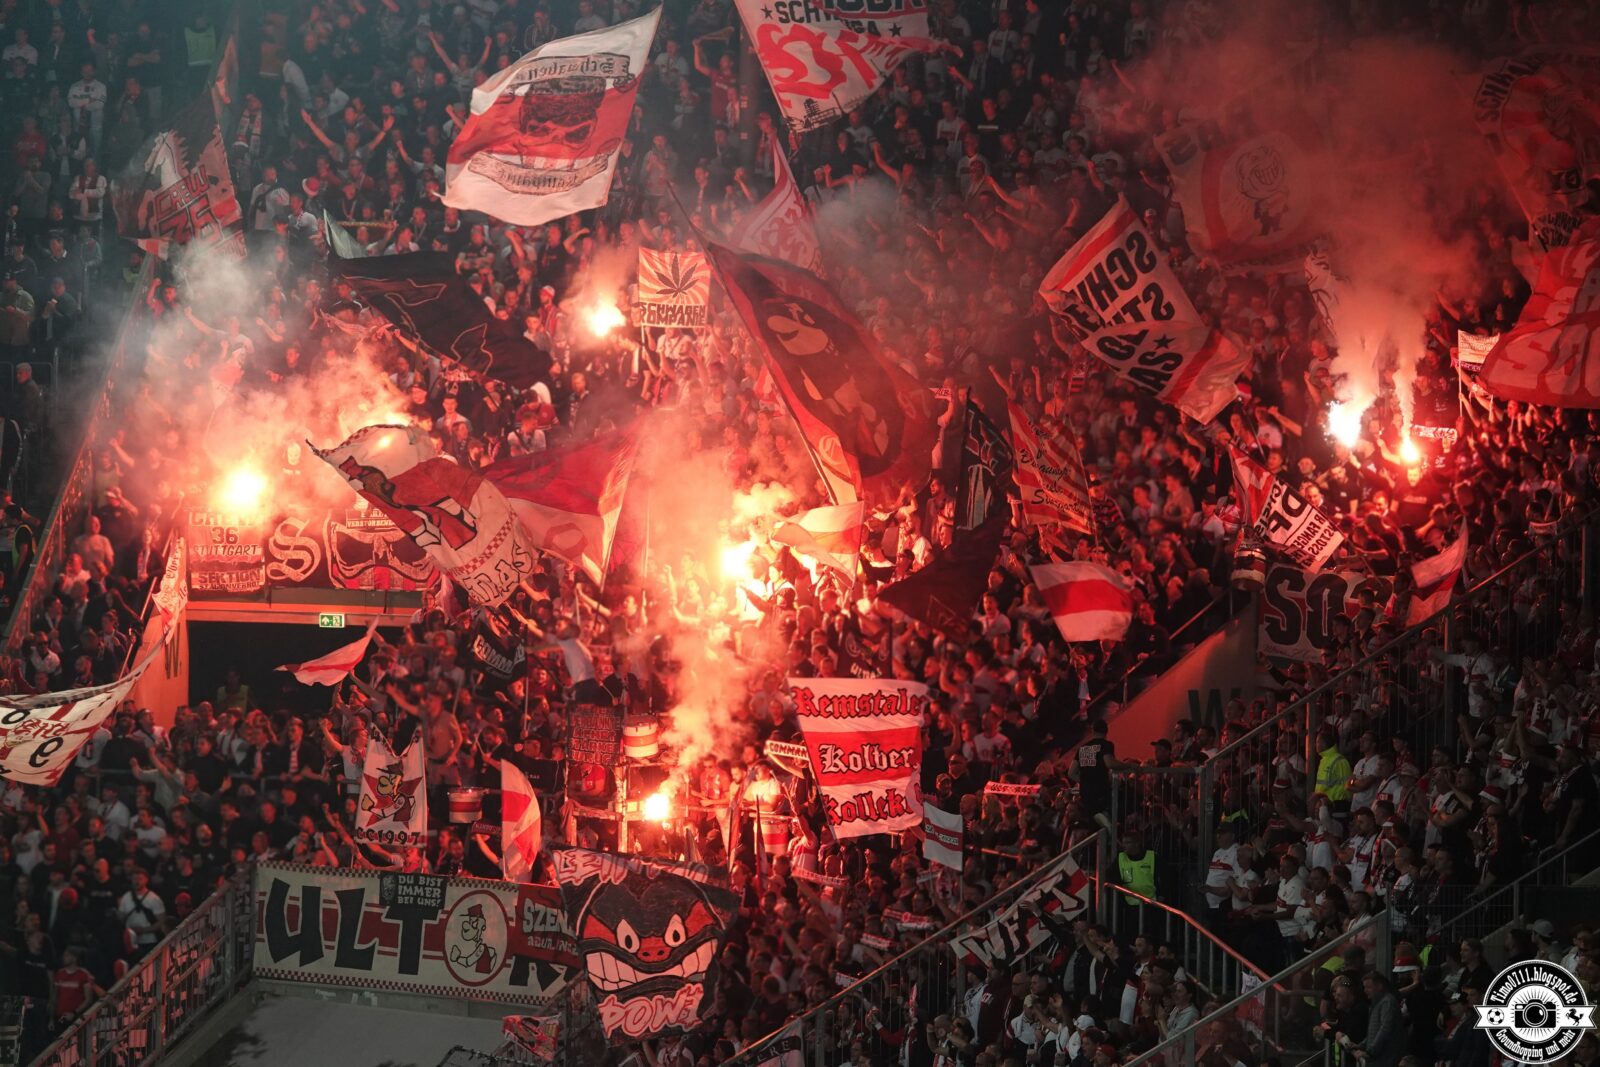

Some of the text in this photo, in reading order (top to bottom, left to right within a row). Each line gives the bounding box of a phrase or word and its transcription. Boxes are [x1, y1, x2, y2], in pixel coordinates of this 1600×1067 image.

[212, 526, 239, 544] 36
[194, 544, 259, 557] STUTTGART
[198, 569, 261, 584] SEKTION
[397, 875, 443, 888] DU BIST
[397, 886, 441, 898] IMMER
[397, 896, 441, 908] BEI UNS!
